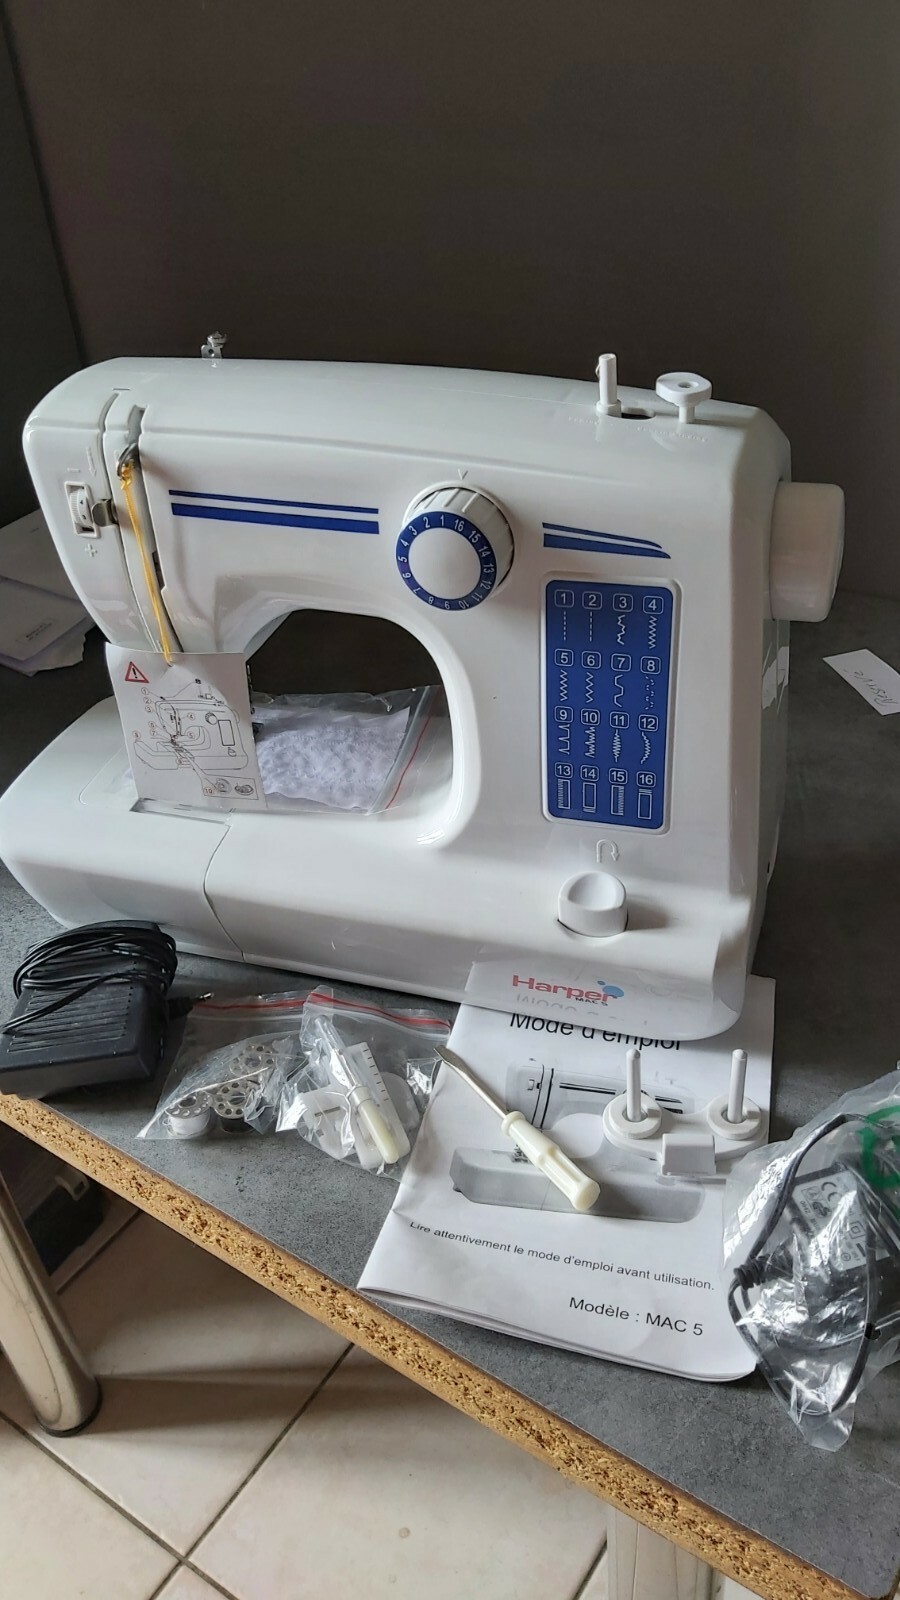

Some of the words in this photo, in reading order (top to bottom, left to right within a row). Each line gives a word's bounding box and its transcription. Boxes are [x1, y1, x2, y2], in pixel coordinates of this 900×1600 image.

[423, 516, 431, 529] 2
[440, 514, 444, 526] 1
[454, 519, 465, 532] 16
[408, 525, 418, 536] 3
[468, 530, 481, 543] 15
[400, 538, 410, 547] 4
[479, 546, 491, 557] 14
[483, 563, 495, 574] 13
[412, 587, 421, 595] 7
[480, 580, 491, 590] 12
[428, 596, 435, 605] 8
[471, 591, 483, 602] 11
[560, 592, 566, 604] 1
[588, 594, 597, 606] 2
[618, 596, 628, 609] 3
[648, 599, 657, 611] 4
[444, 600, 451, 610] 9
[458, 600, 470, 610] 10
[560, 652, 569, 664] 5
[586, 654, 596, 666] 6
[617, 657, 626, 669] 7
[646, 660, 656, 672] 8
[559, 709, 568, 720] 9
[583, 712, 598, 723] 10
[612, 714, 625, 726] 11
[641, 717, 656, 729] 12
[556, 764, 571, 776] 13
[582, 769, 596, 779] 14
[611, 771, 625, 782] 15
[639, 774, 654, 785] 16
[512, 975, 618, 1002] Harper
[409, 1221, 431, 1233] Lire
[433, 1228, 511, 1252] attentivement
[513, 1245, 524, 1255] le
[527, 1249, 560, 1262] mode
[563, 1255, 614, 1273] d'emploi
[616, 1266, 651, 1280] avant
[653, 1272, 715, 1291] utilisation.
[568, 1296, 630, 1321] Modèle
[635, 1313, 640, 1323] :
[645, 1312, 687, 1333] MAC
[692, 1323, 704, 1336] 5
